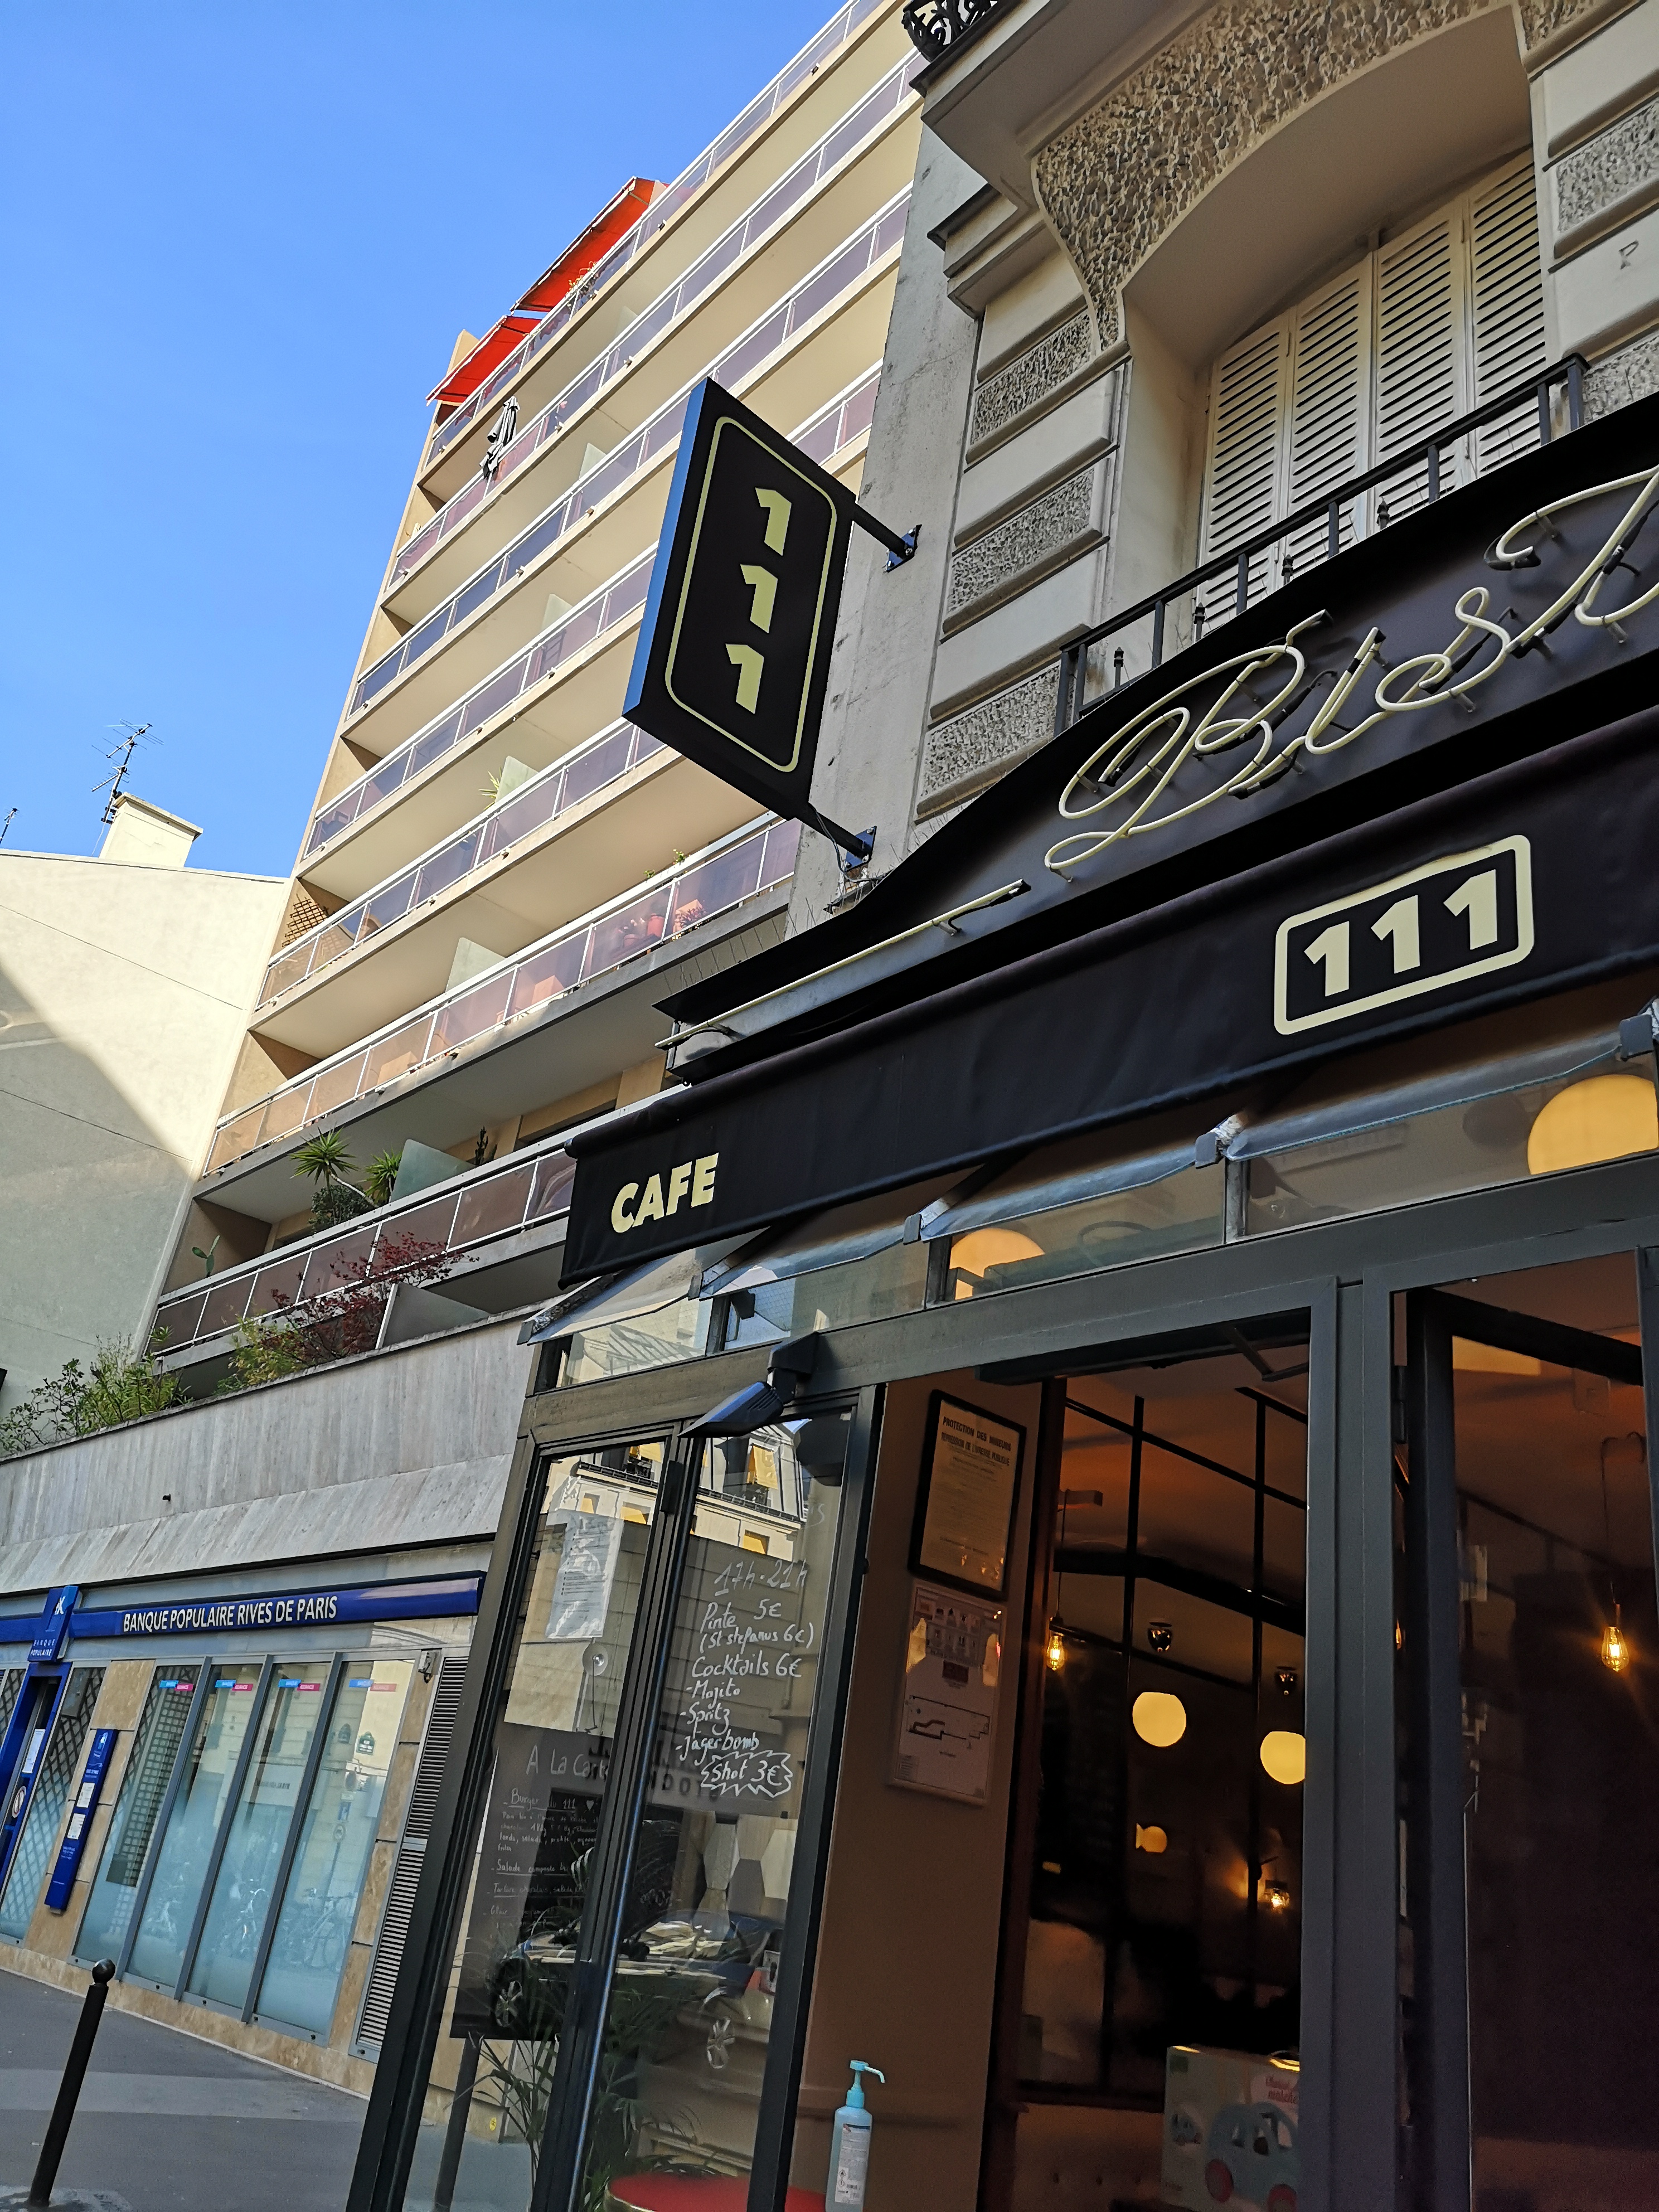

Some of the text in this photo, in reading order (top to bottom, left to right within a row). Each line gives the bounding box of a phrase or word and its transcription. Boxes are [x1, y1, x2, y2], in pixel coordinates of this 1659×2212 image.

[1303, 869, 1498, 997] 111
[611, 1152, 719, 1234] CAFE
[123, 1595, 338, 1633] BANQUE POPULAIRE RIVES DE PARIS
[700, 1598, 782, 1634] Pinte 5€
[33, 1638, 56, 1647] BANQUE
[692, 1650, 802, 1678] Cocktails 6€
[526, 1745, 539, 1775] A
[750, 1759, 782, 1786] 3€
[511, 1787, 540, 1812] Burger
[496, 1858, 521, 1873] Salade
